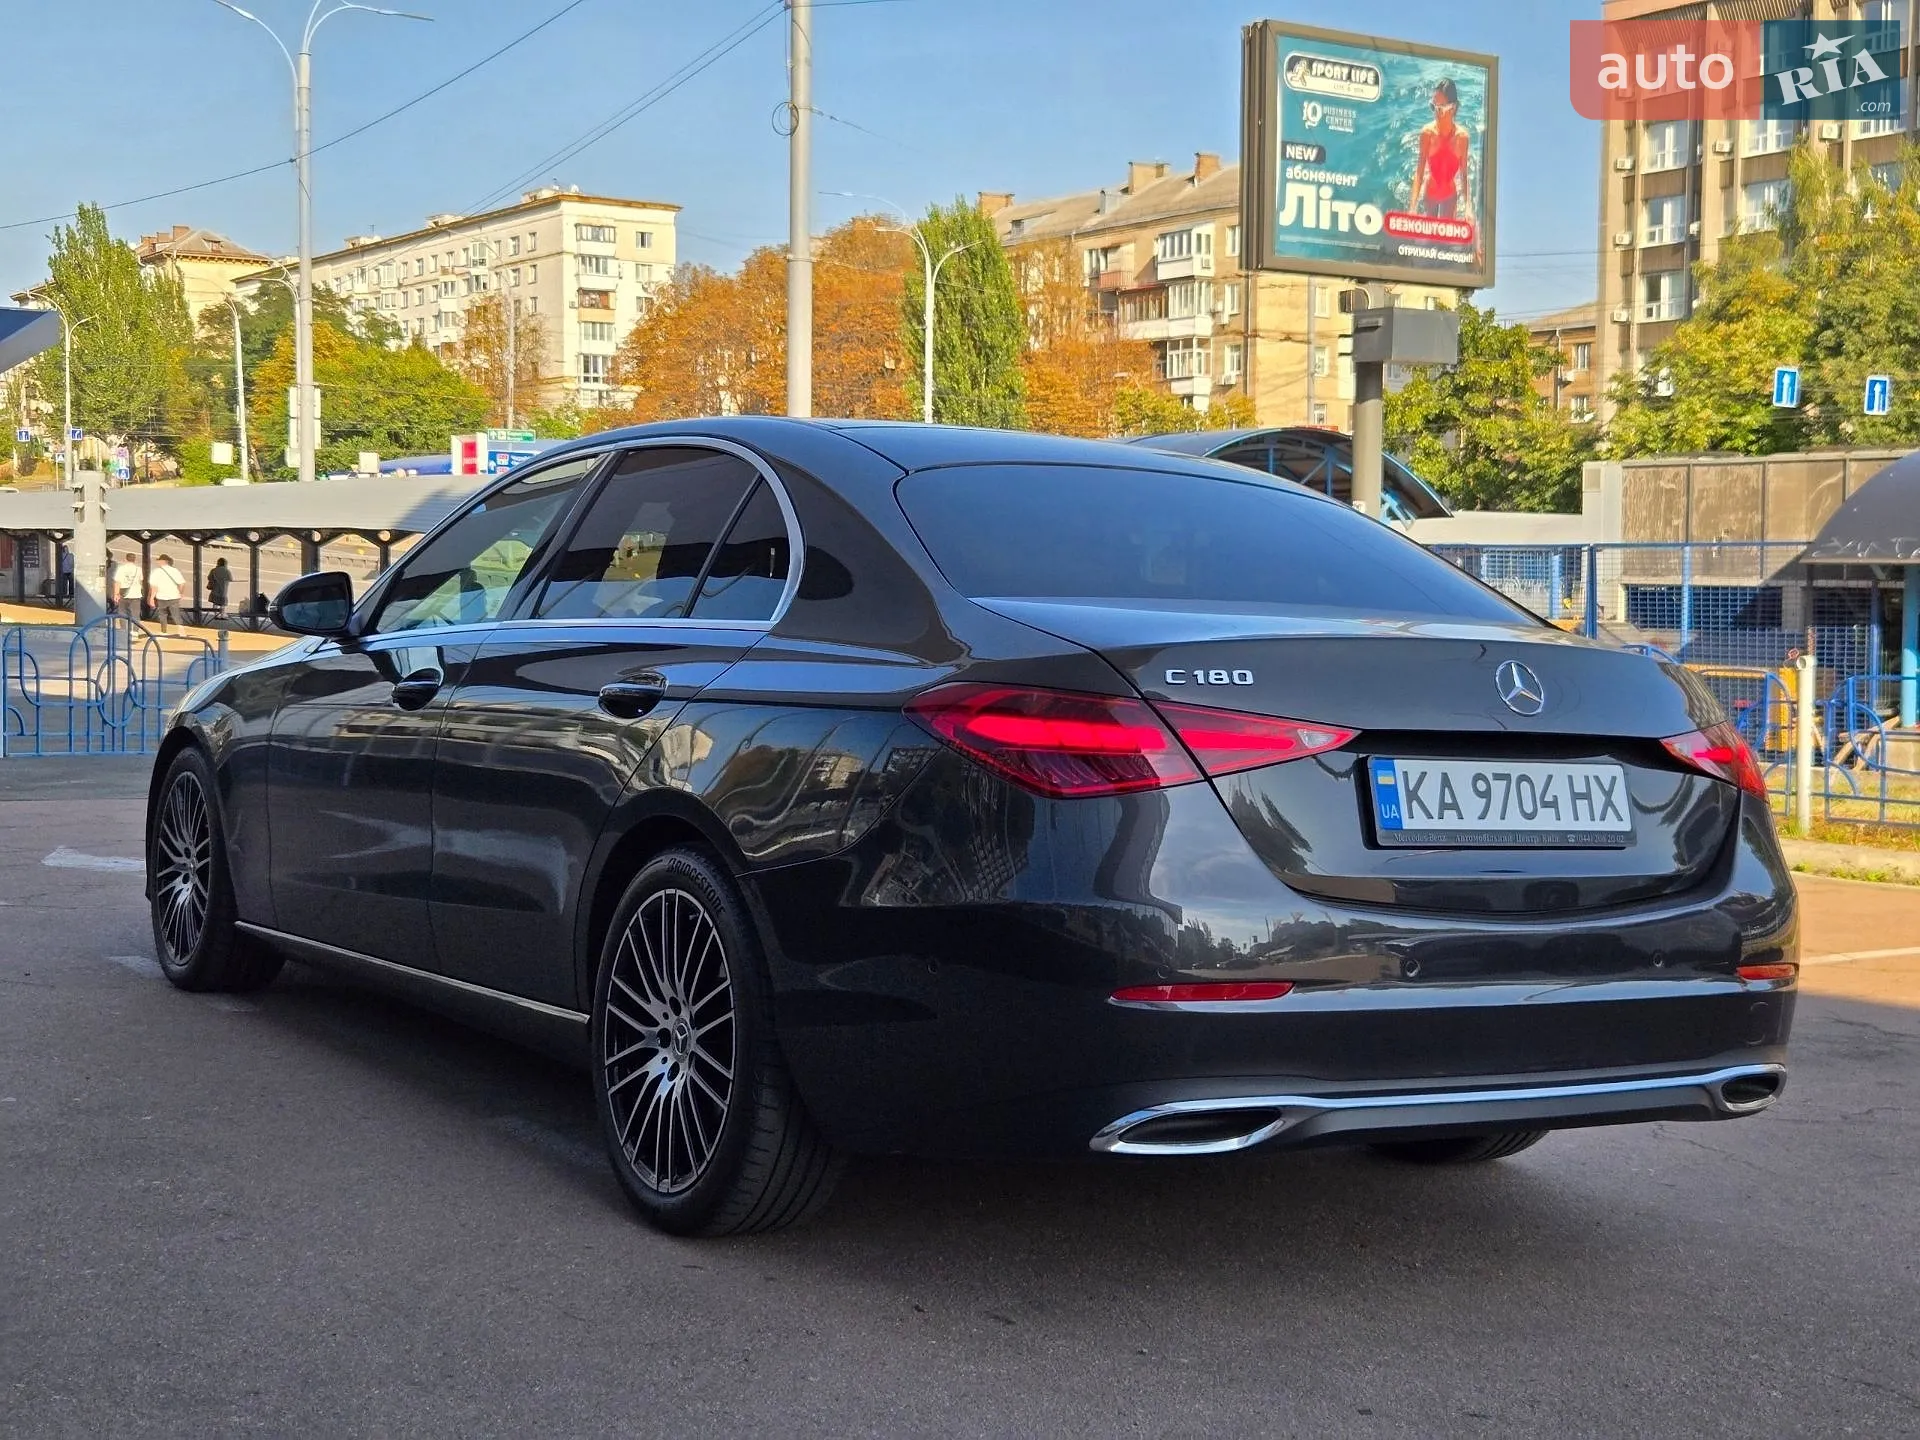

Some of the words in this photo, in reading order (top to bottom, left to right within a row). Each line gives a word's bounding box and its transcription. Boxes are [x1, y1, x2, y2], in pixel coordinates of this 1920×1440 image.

[1311, 61, 1349, 81] SPORT
[1286, 144, 1319, 162] NEW
[1285, 164, 1358, 187] абонемент
[1279, 181, 1383, 236] Літо
[1389, 216, 1469, 239] БЕЗКОШТОВНО
[1398, 244, 1437, 259] ОТРИМАЙ
[1165, 669, 1186, 685] C
[1192, 669, 1254, 685] 180
[1402, 771, 1464, 820] KA
[1471, 772, 1561, 821] 9704
[1567, 775, 1624, 822] HX
[1381, 803, 1400, 819] UA
